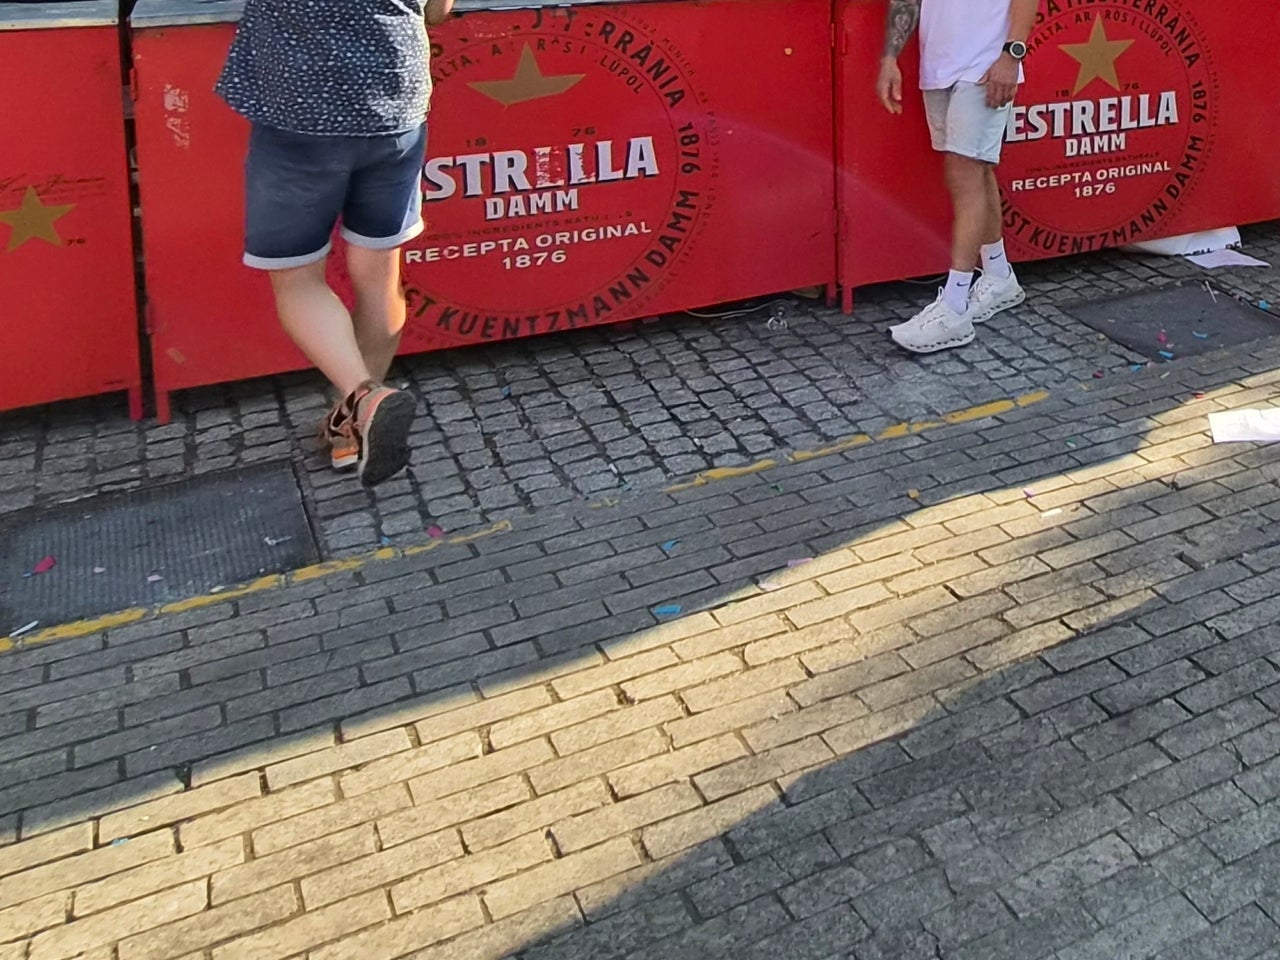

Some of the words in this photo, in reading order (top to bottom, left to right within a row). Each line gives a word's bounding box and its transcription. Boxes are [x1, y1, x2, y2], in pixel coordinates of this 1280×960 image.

[1005, 91, 1179, 142] ESTRELLA
[1192, 81, 1207, 123] 1876
[678, 122, 701, 174] 1876
[1065, 133, 1126, 157] DAMM
[1011, 171, 1090, 191] RECEPTA
[1096, 161, 1171, 180] ORIGINAL
[1165, 135, 1204, 200] DAMM
[485, 189, 579, 220] DAMM
[1074, 183, 1116, 198] 1876
[405, 238, 529, 264] RECEPTA
[535, 221, 652, 248] ORIGINAL
[645, 190, 700, 268] DAMM
[502, 250, 567, 269] 1876
